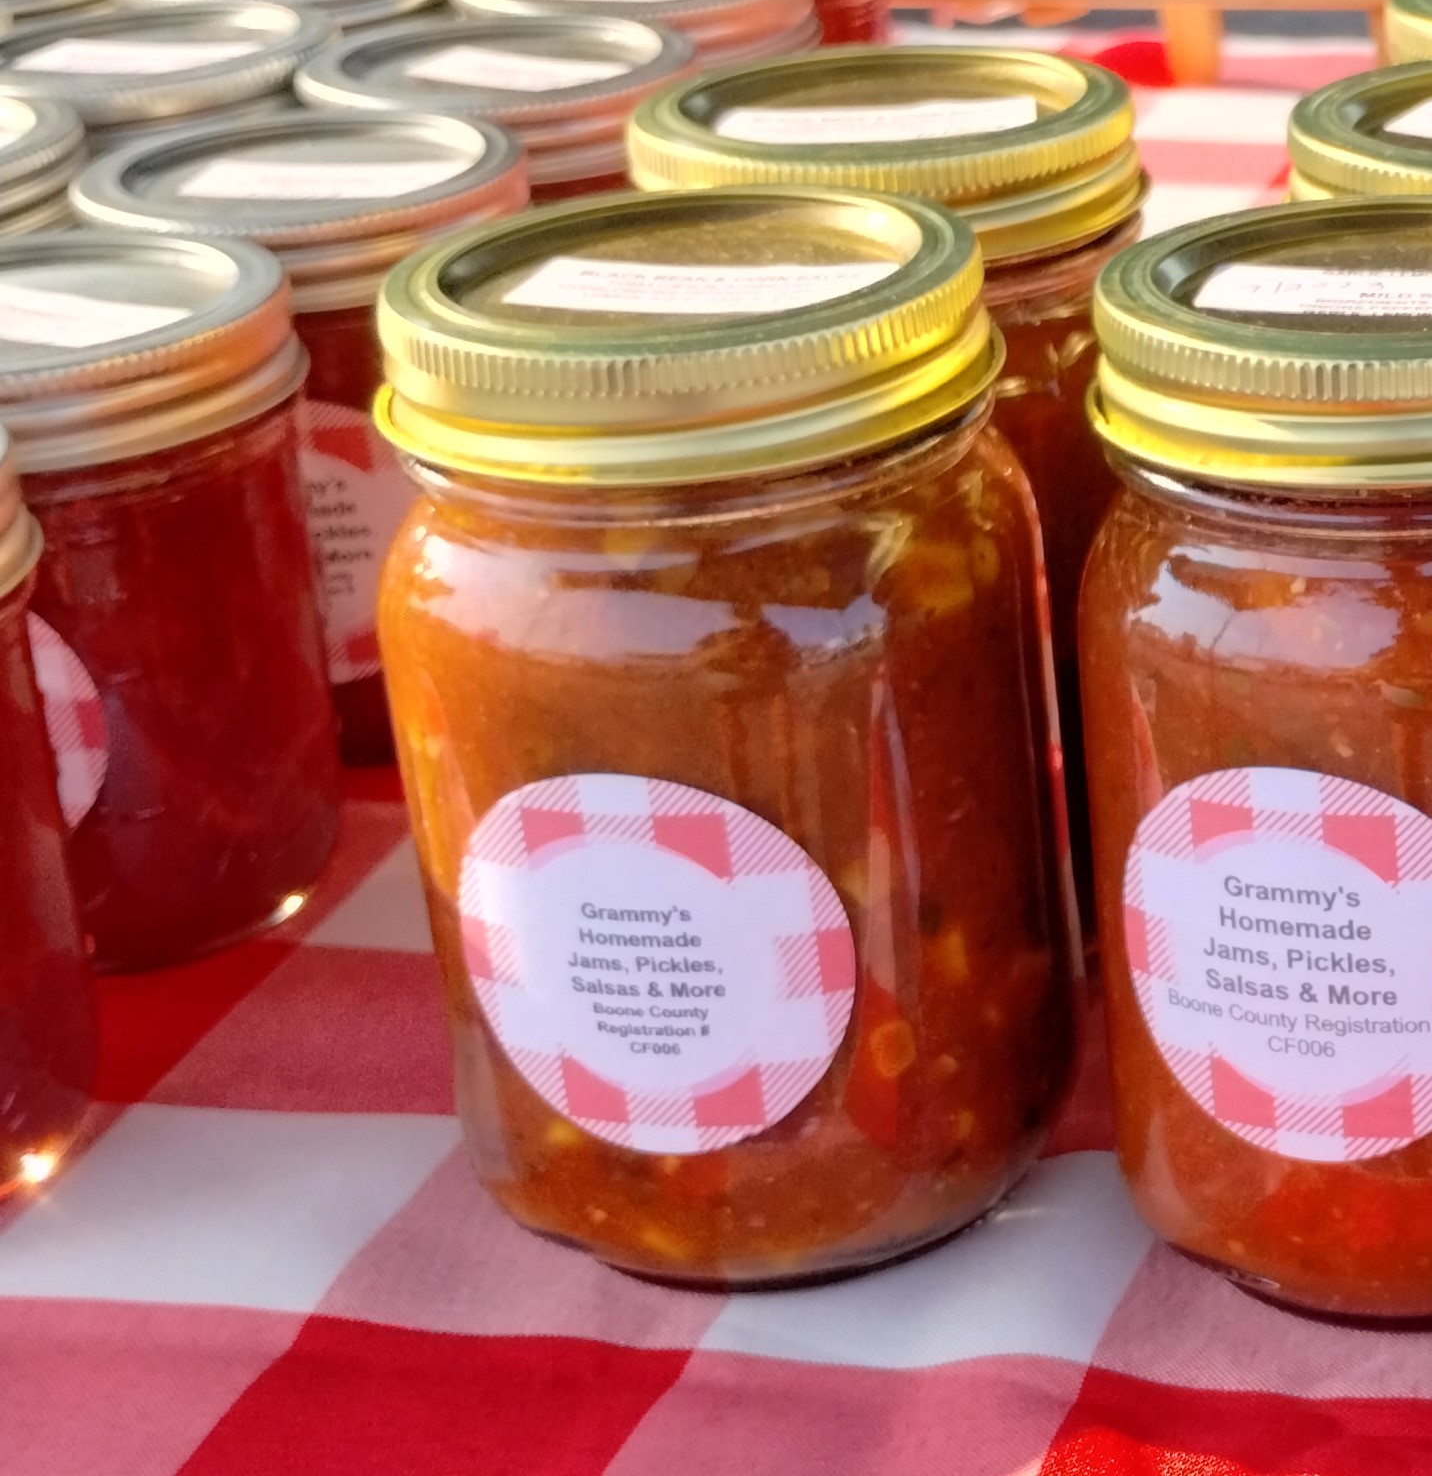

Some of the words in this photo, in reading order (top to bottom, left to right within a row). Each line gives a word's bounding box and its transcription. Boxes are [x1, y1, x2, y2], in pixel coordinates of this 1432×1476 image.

[1223, 875, 1361, 912] Grammy's
[581, 902, 692, 926] Grammy's
[1219, 905, 1372, 942] Homemade
[578, 927, 702, 948] Homemade
[568, 951, 630, 975] Jams,
[635, 955, 723, 975] Pickles,
[1203, 936, 1278, 971] Jams,
[1286, 948, 1396, 977] Pickles,
[571, 976, 641, 997] Salsas
[647, 981, 664, 998] &
[670, 981, 726, 998] More
[1205, 967, 1290, 1001] Salsas
[1299, 981, 1319, 1004] &
[1327, 984, 1398, 1006] More
[593, 1001, 644, 1017] Boone
[649, 1004, 709, 1022] County
[1168, 987, 1223, 1017] Boone
[1228, 1003, 1298, 1033] County
[1304, 1013, 1431, 1037] Registration
[597, 1020, 696, 1038] Registration
[700, 1023, 711, 1038] #
[629, 1040, 682, 1056] CF006
[1267, 1035, 1336, 1058] CF006
